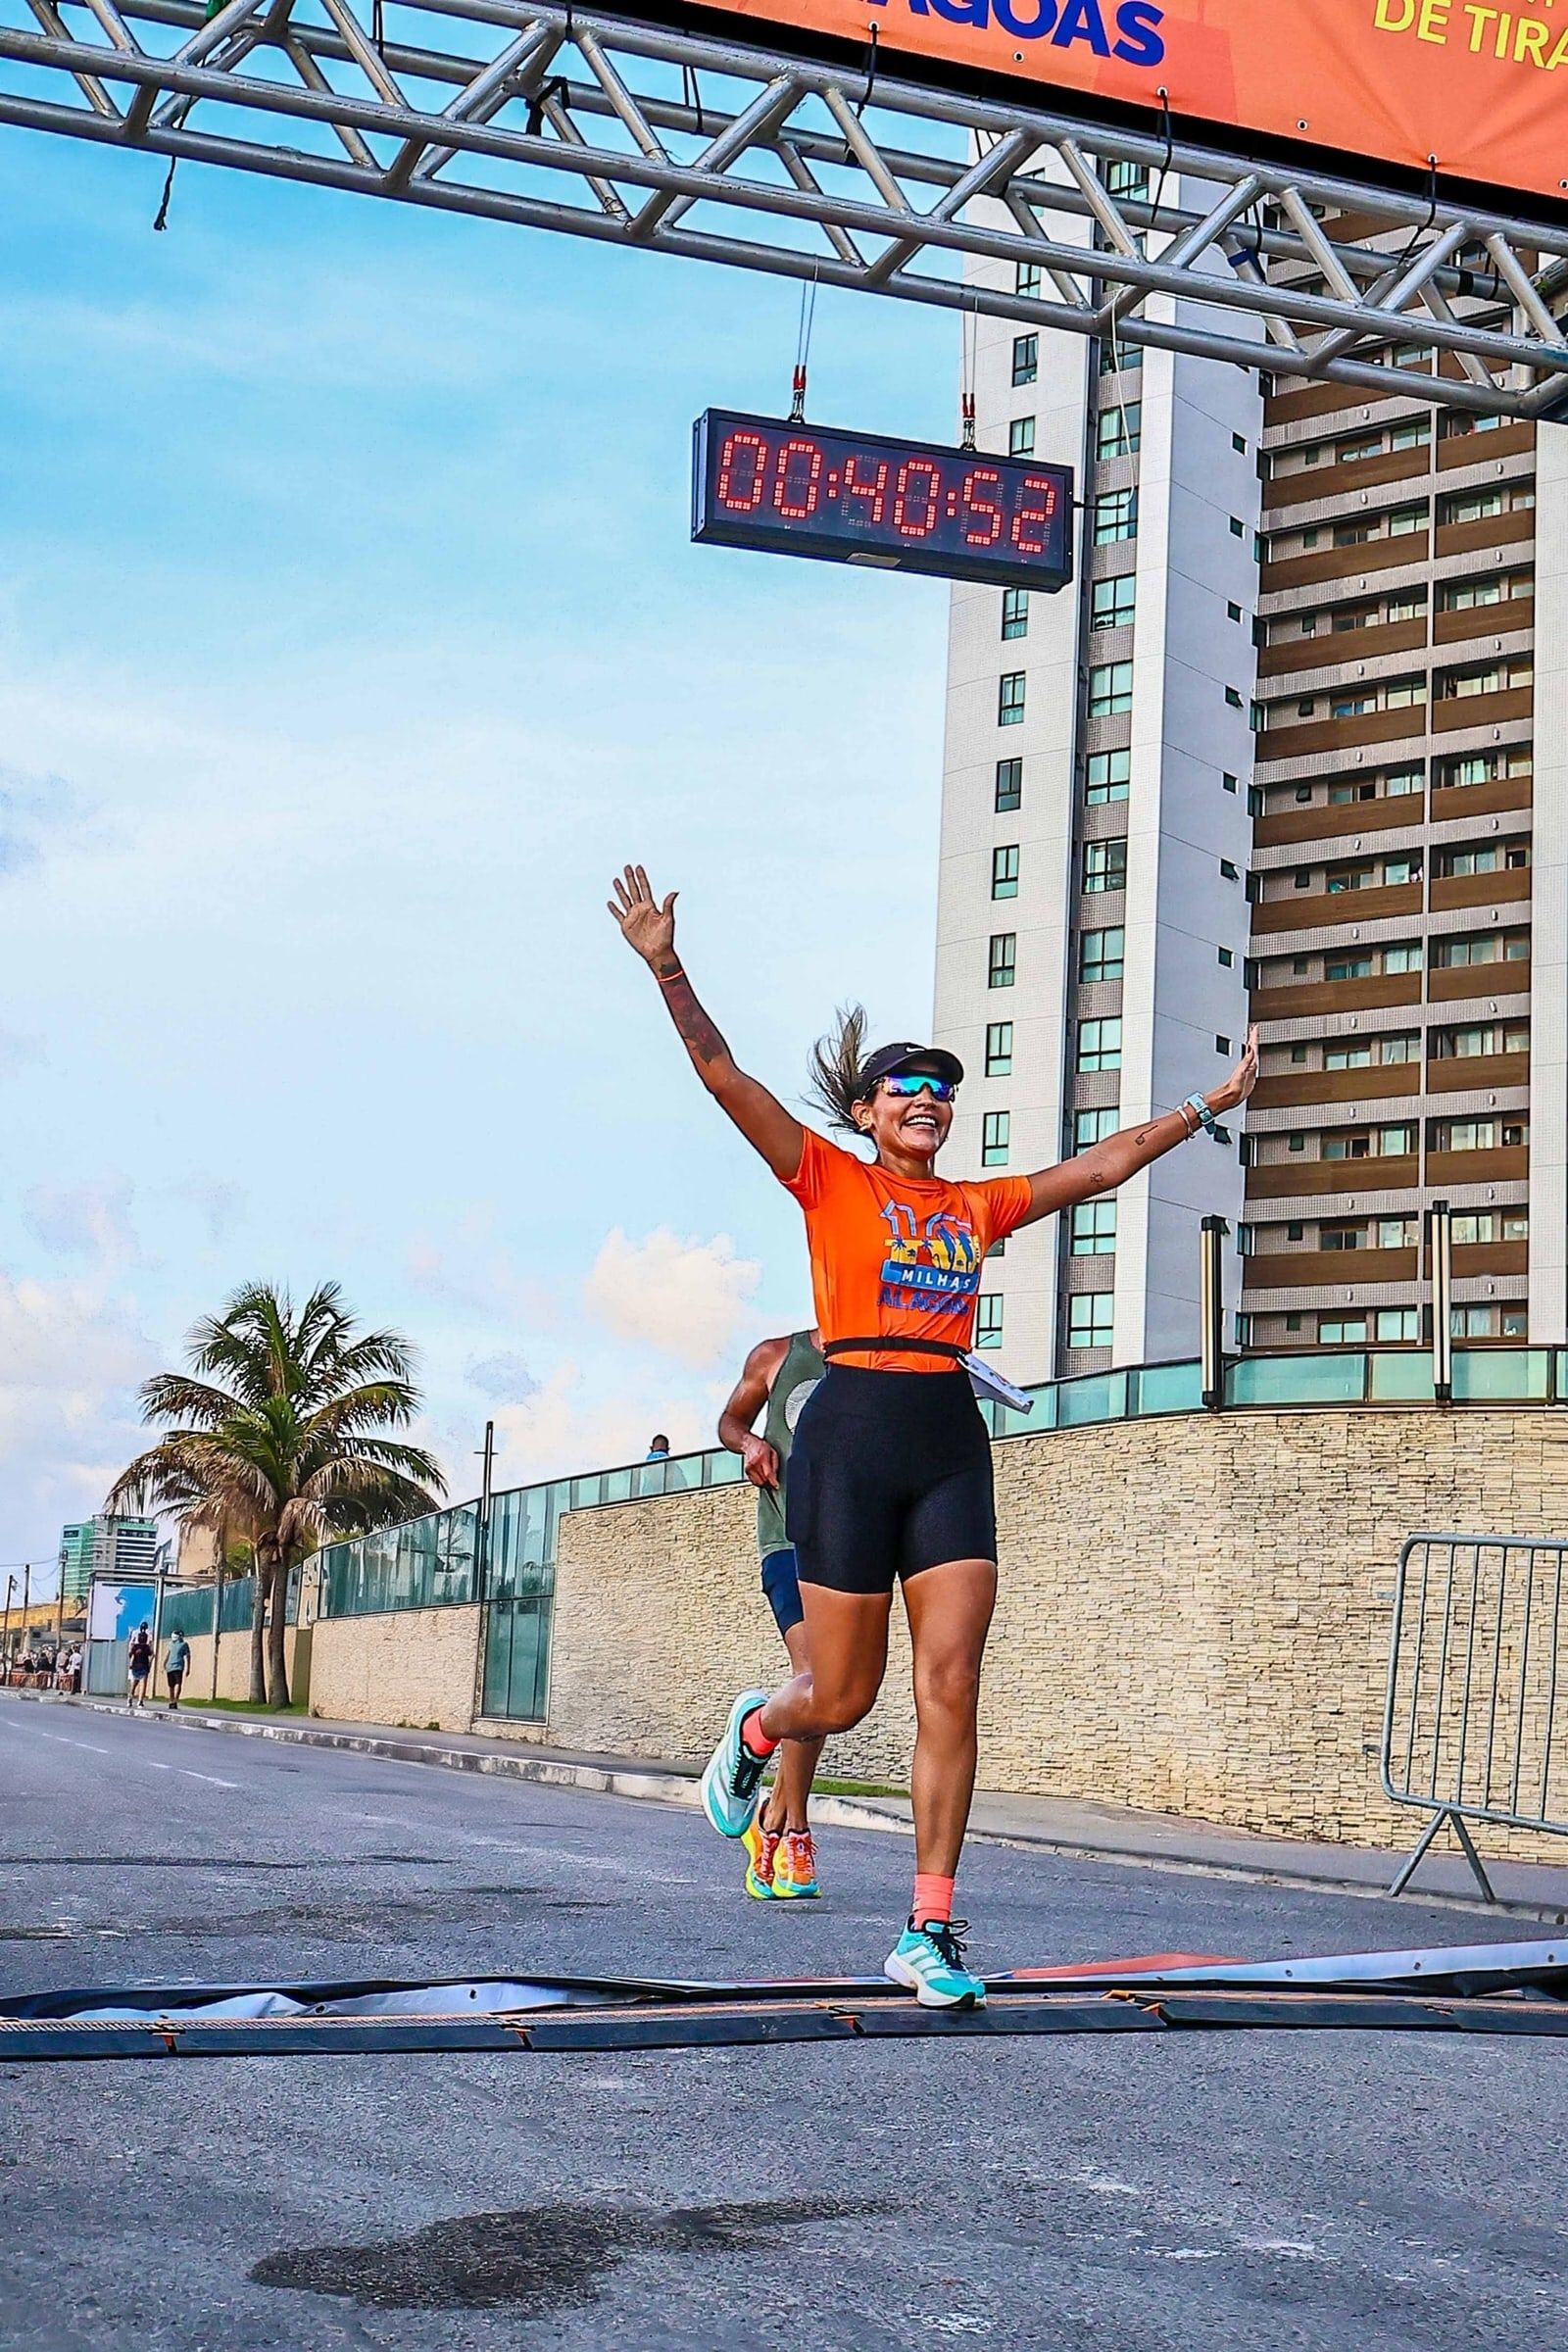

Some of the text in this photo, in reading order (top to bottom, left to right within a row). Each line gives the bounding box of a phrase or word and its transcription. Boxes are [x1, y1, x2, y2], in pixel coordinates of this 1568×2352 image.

[1374, 0, 1447, 45] DE
[718, 433, 1055, 553] 00:40:52
[901, 1268, 972, 1290] MILHAS
